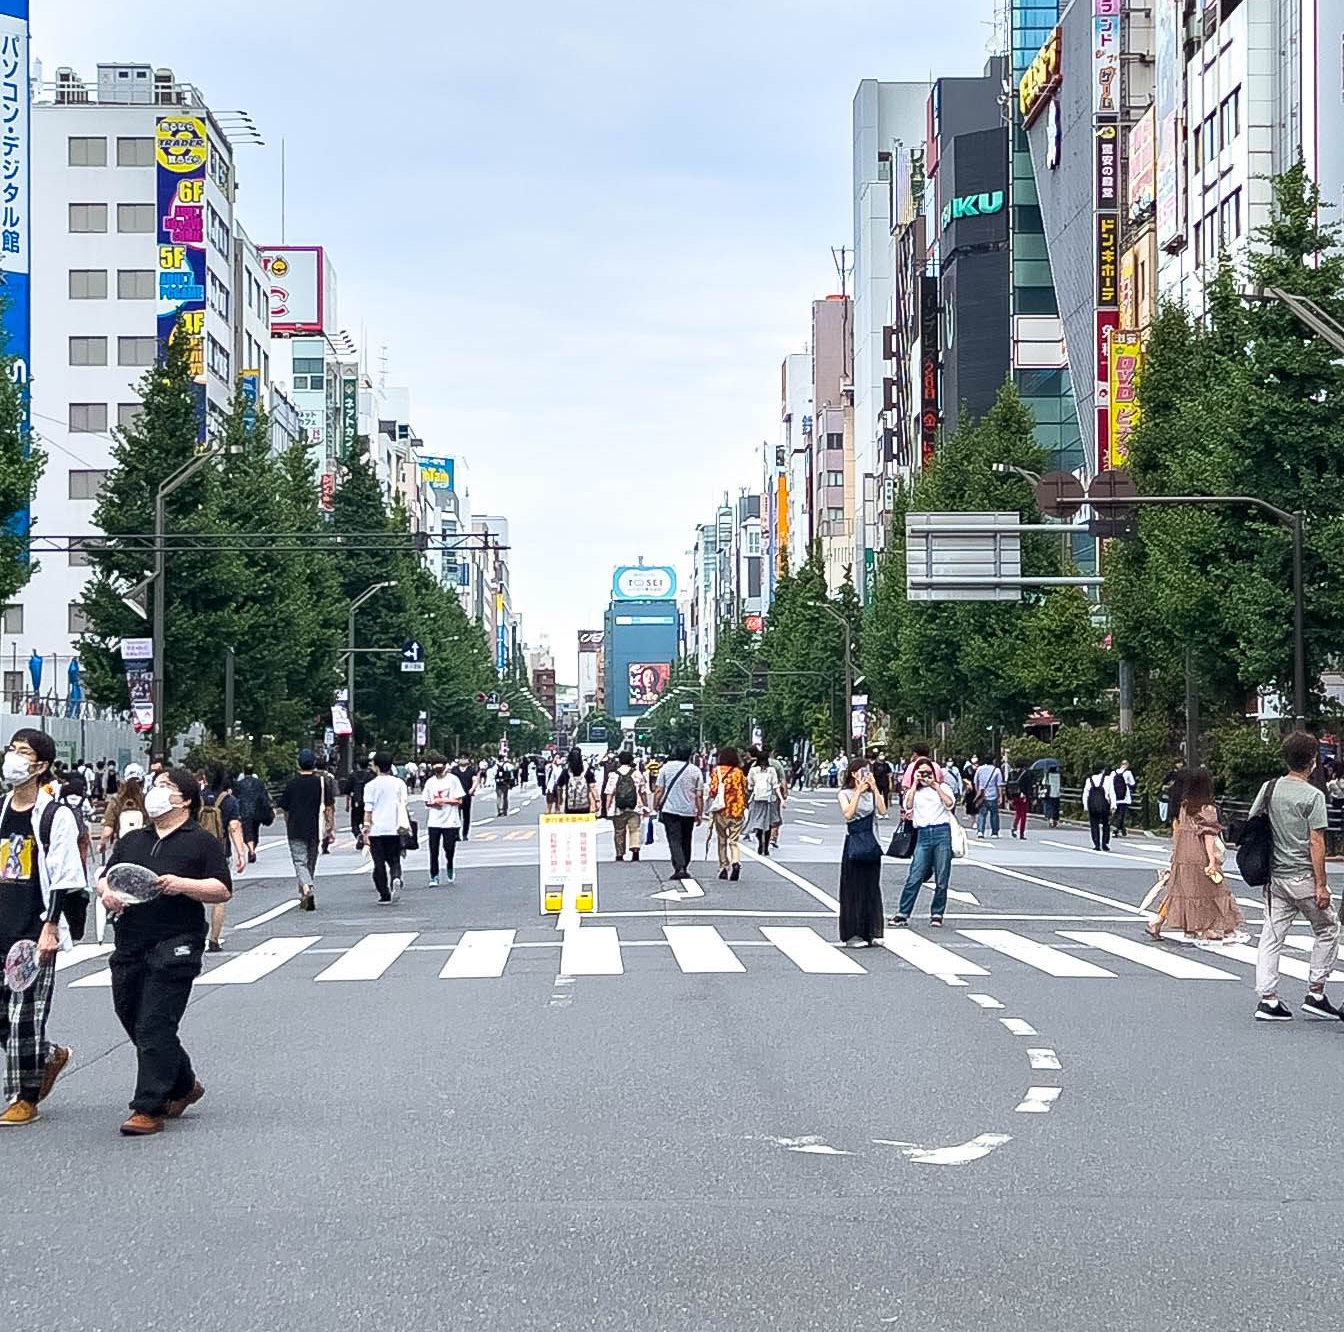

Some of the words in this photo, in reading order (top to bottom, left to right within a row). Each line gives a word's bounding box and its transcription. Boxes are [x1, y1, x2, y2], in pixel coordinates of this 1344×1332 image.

[1, 34, 21, 254] パソコン・デジタル館
[178, 179, 204, 203] 6F
[159, 246, 186, 269] 5F
